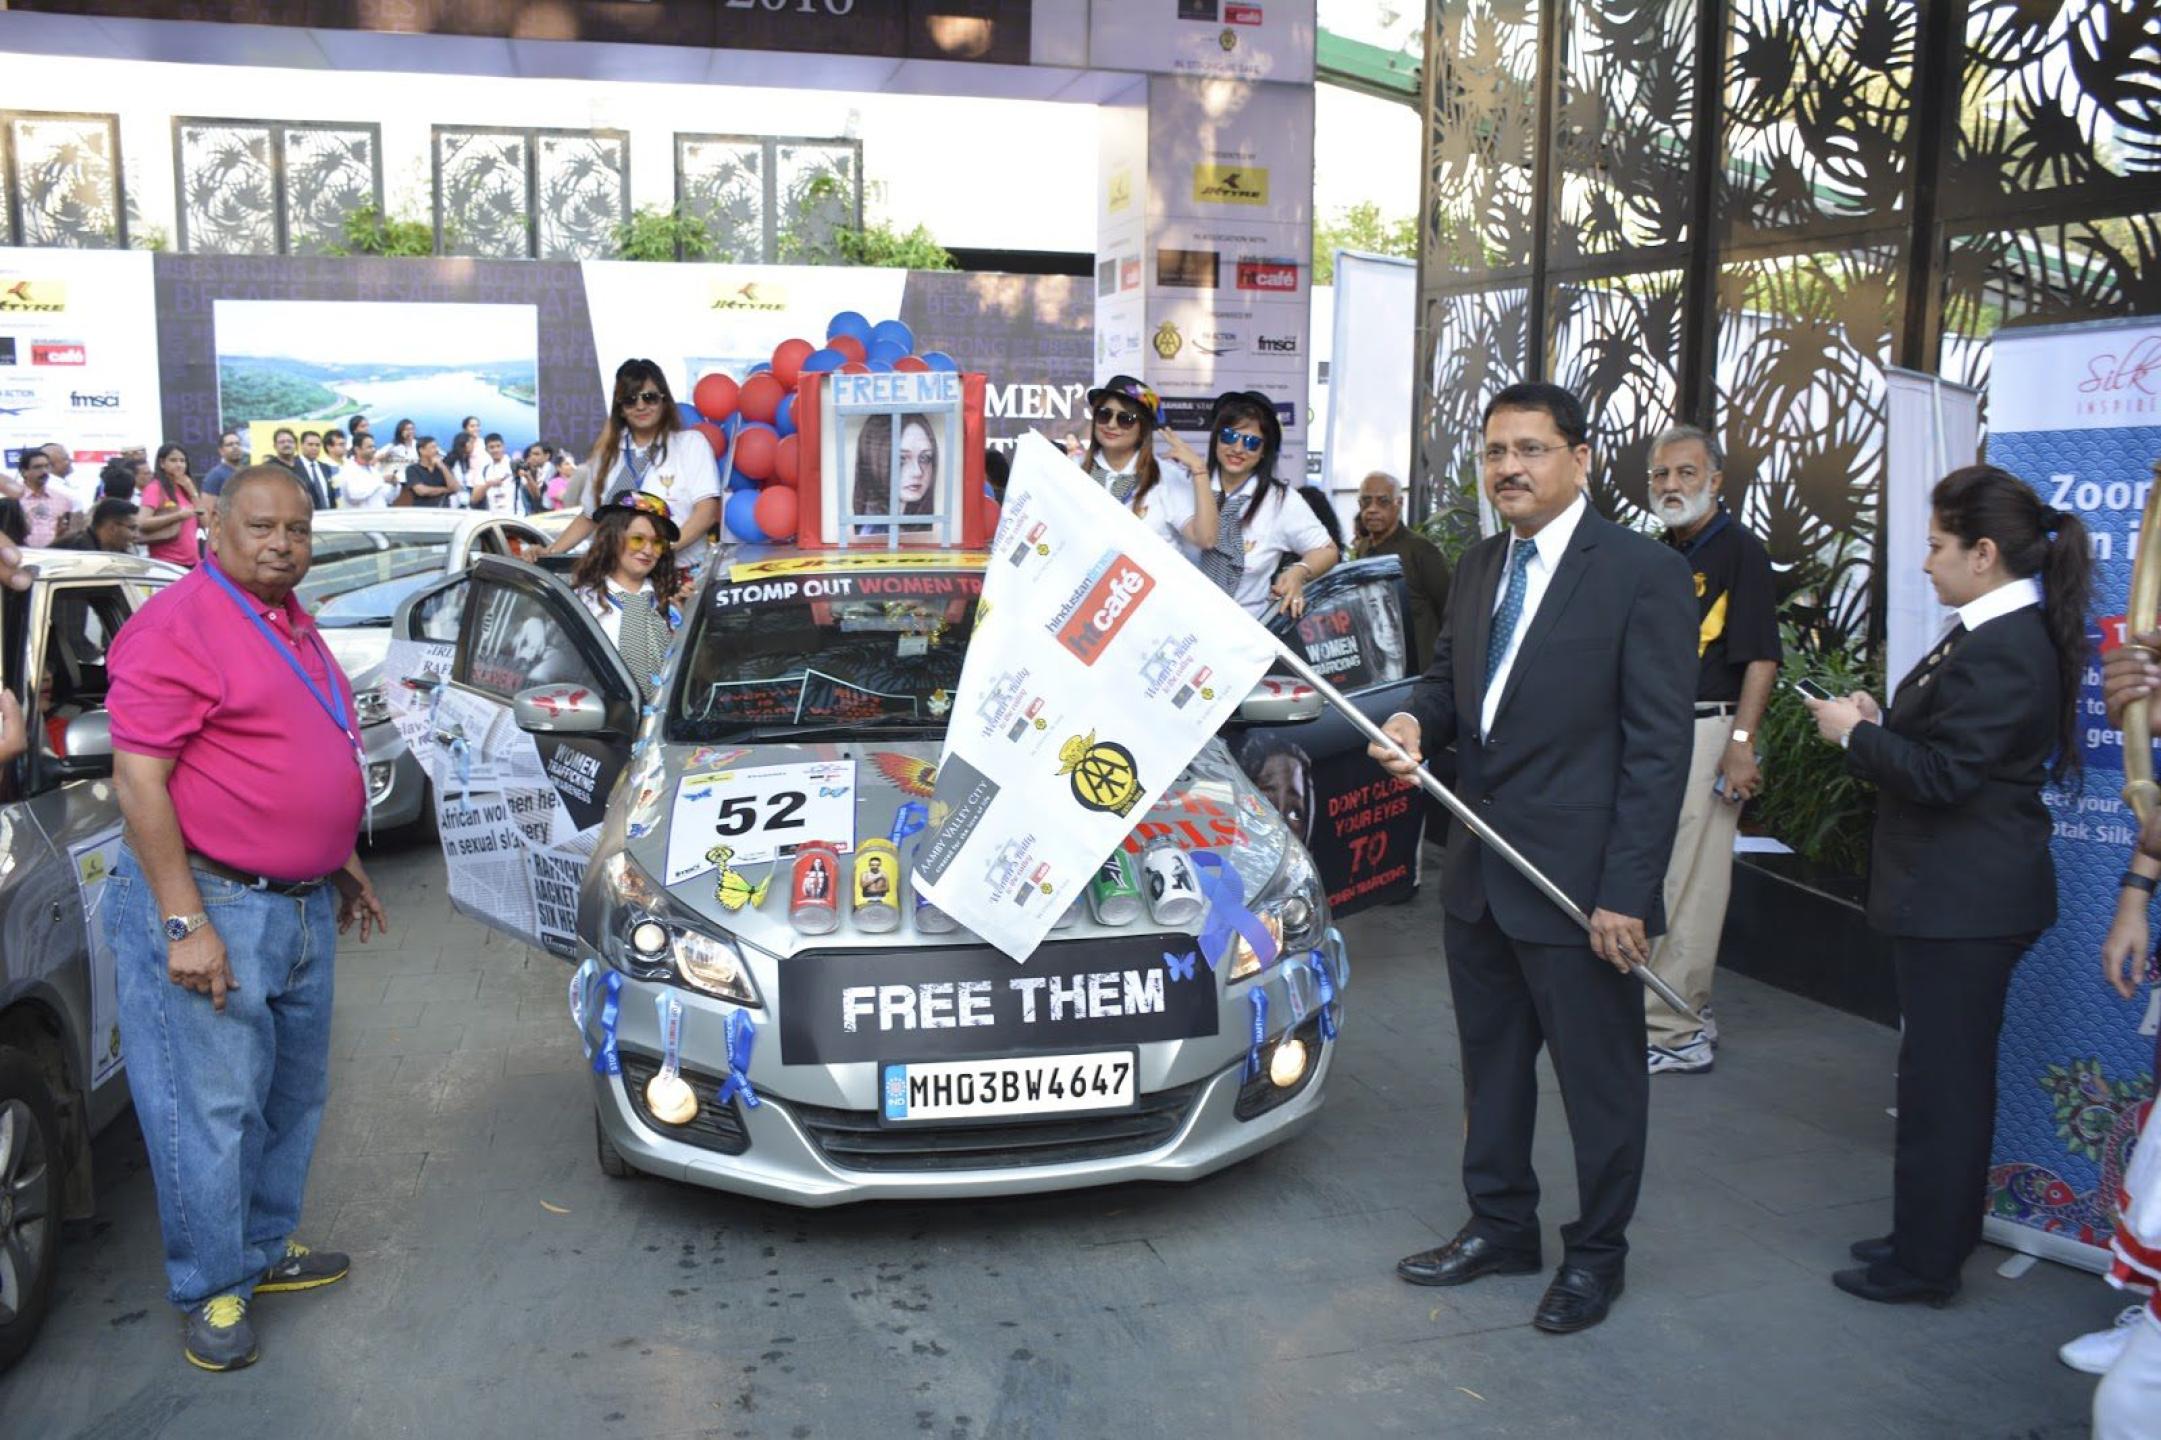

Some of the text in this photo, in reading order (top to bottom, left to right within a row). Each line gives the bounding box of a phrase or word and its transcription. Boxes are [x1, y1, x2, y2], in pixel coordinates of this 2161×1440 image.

[71, 390, 120, 408] fmsci
[834, 373, 959, 402] FREE ME
[715, 580, 798, 608] STOMP
[803, 577, 853, 598] OUT
[857, 576, 953, 596] WOMEN
[1305, 635, 1359, 663] WOMEN
[555, 743, 601, 778] WOMEN
[715, 790, 807, 837] 52
[942, 805, 971, 839] VALLEY
[967, 780, 988, 805] CITY
[1328, 785, 1370, 817] DON'T
[1334, 796, 1410, 838] YOUR EYES
[2076, 797, 2124, 815] your
[458, 831, 498, 855] sexual
[2095, 824, 2136, 845] Silk
[1348, 829, 1390, 875] TO
[842, 968, 1166, 1033] FREE THEM
[909, 1062, 1130, 1108] MH03BW4647
